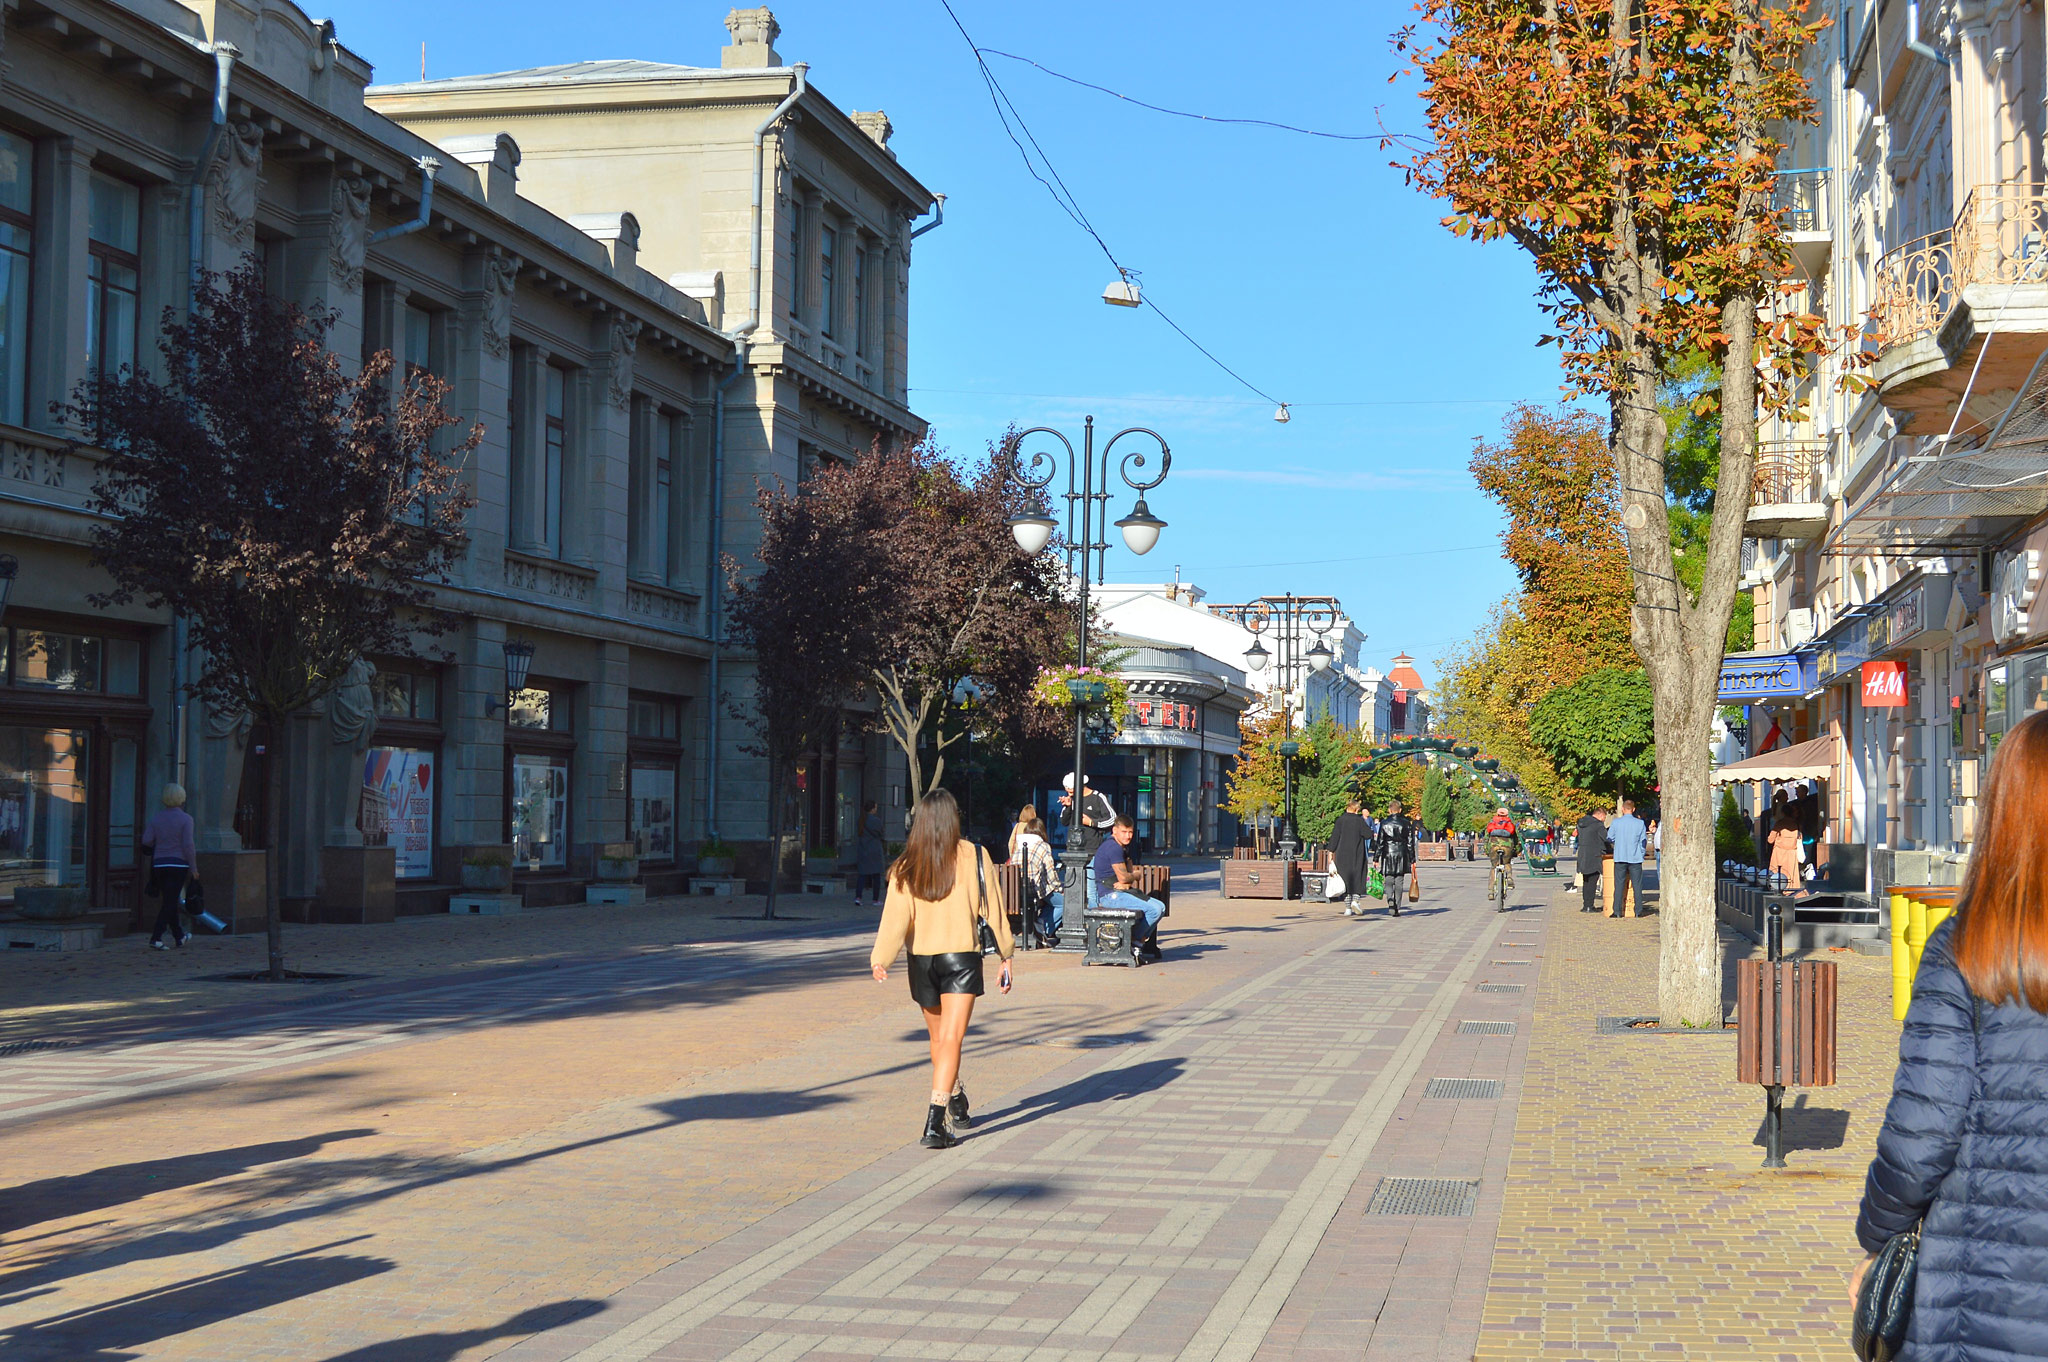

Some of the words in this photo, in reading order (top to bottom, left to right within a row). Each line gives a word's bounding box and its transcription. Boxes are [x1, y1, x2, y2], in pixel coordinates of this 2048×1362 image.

[1718, 669, 1792, 690] ПАРИС
[1865, 671, 1905, 697] H&M
[410, 799, 429, 815] ТЕБЯ
[378, 818, 429, 833] РЕСПУБЛИКА
[405, 836, 428, 851] КРЫМ
